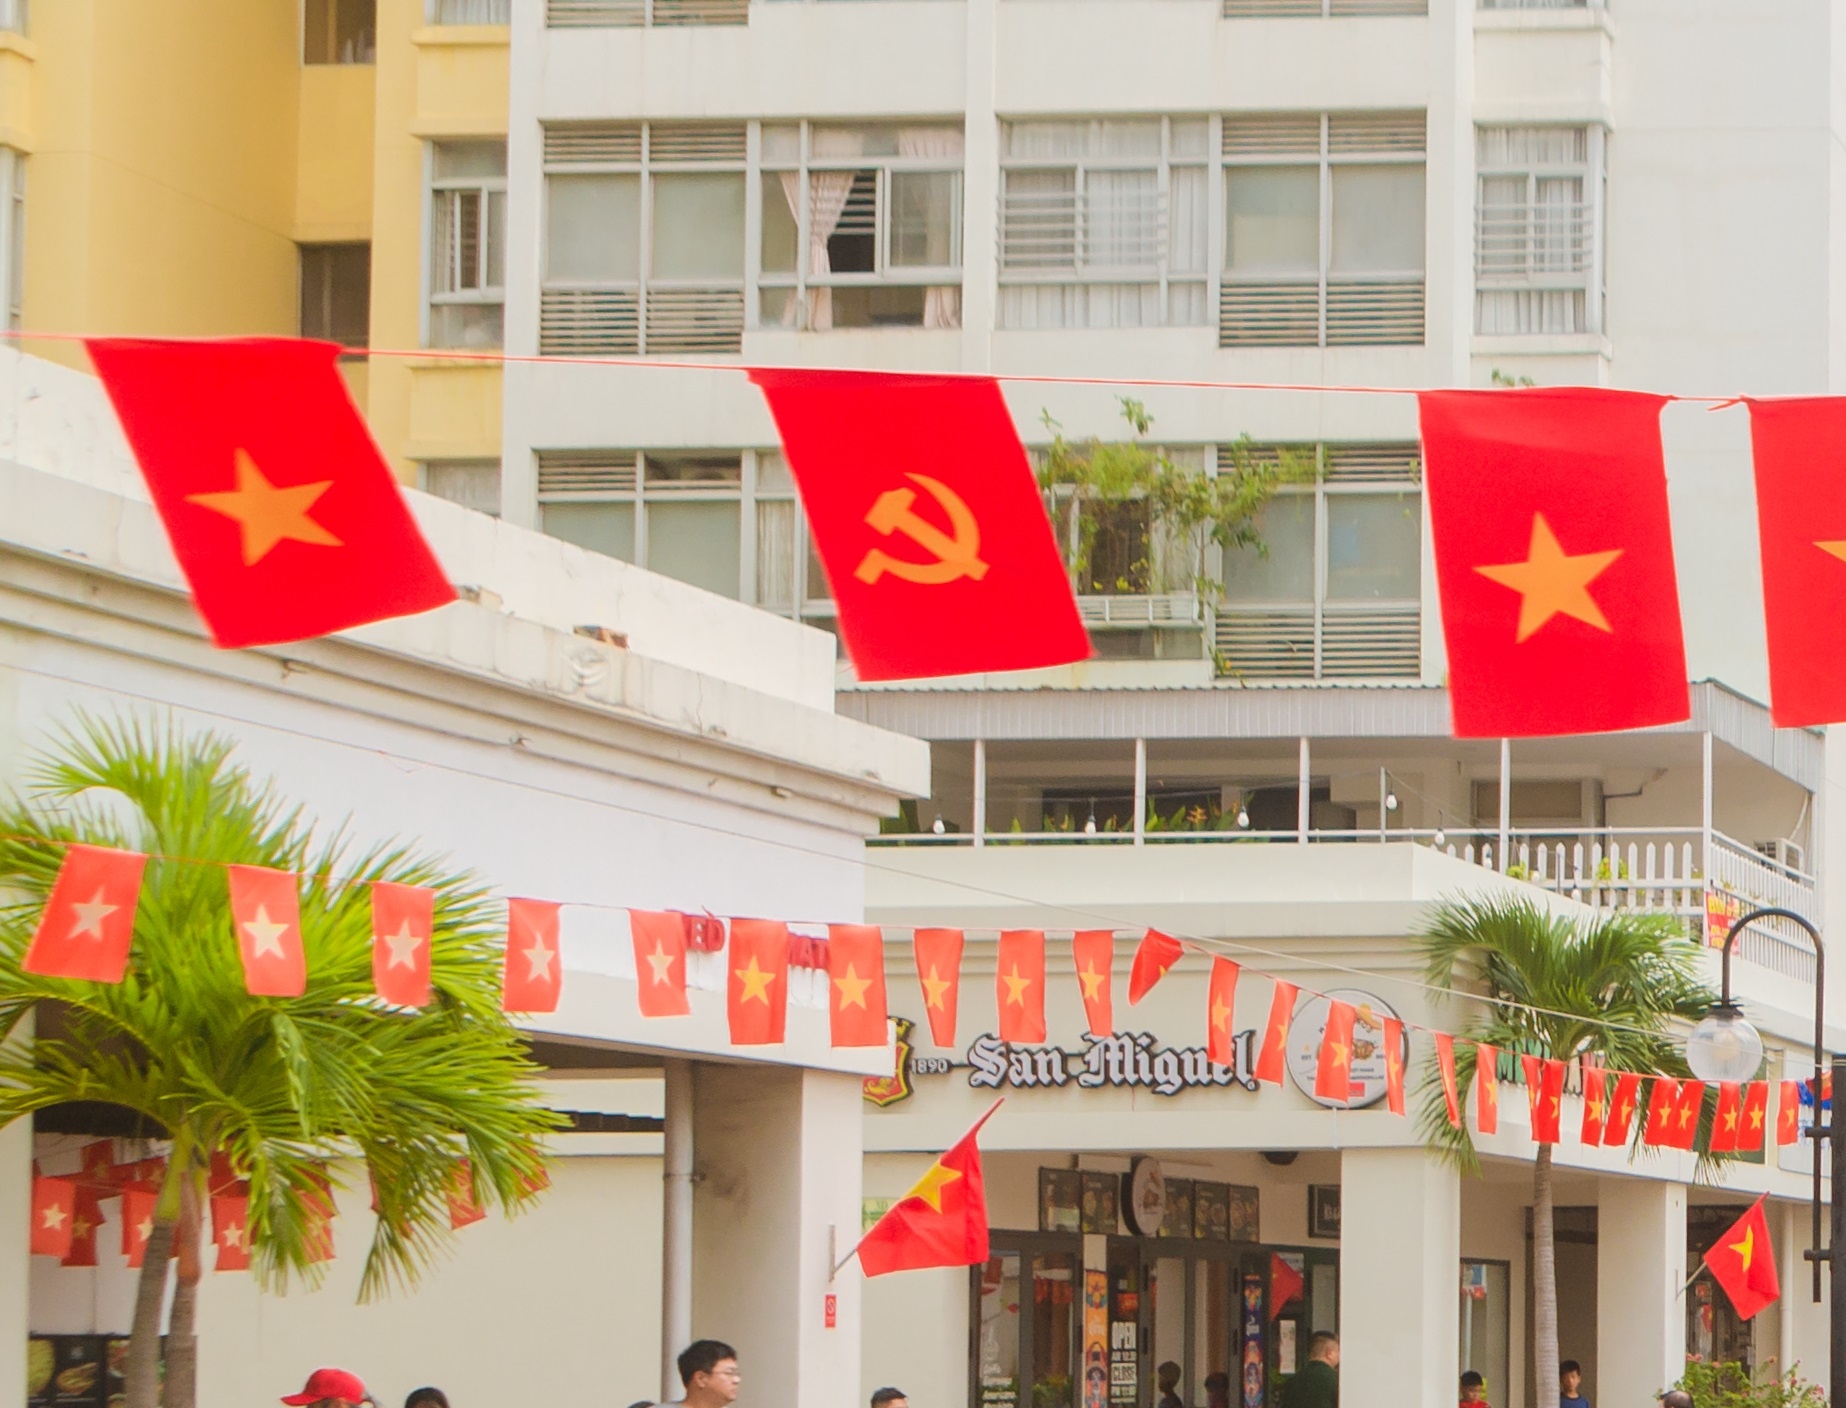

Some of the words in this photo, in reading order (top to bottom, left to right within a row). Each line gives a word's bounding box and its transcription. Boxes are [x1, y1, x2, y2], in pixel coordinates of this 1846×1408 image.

[911, 1058, 948, 1074] 1890
[967, 1032, 1066, 1088] San
[1077, 1031, 1256, 1095] Miguel
